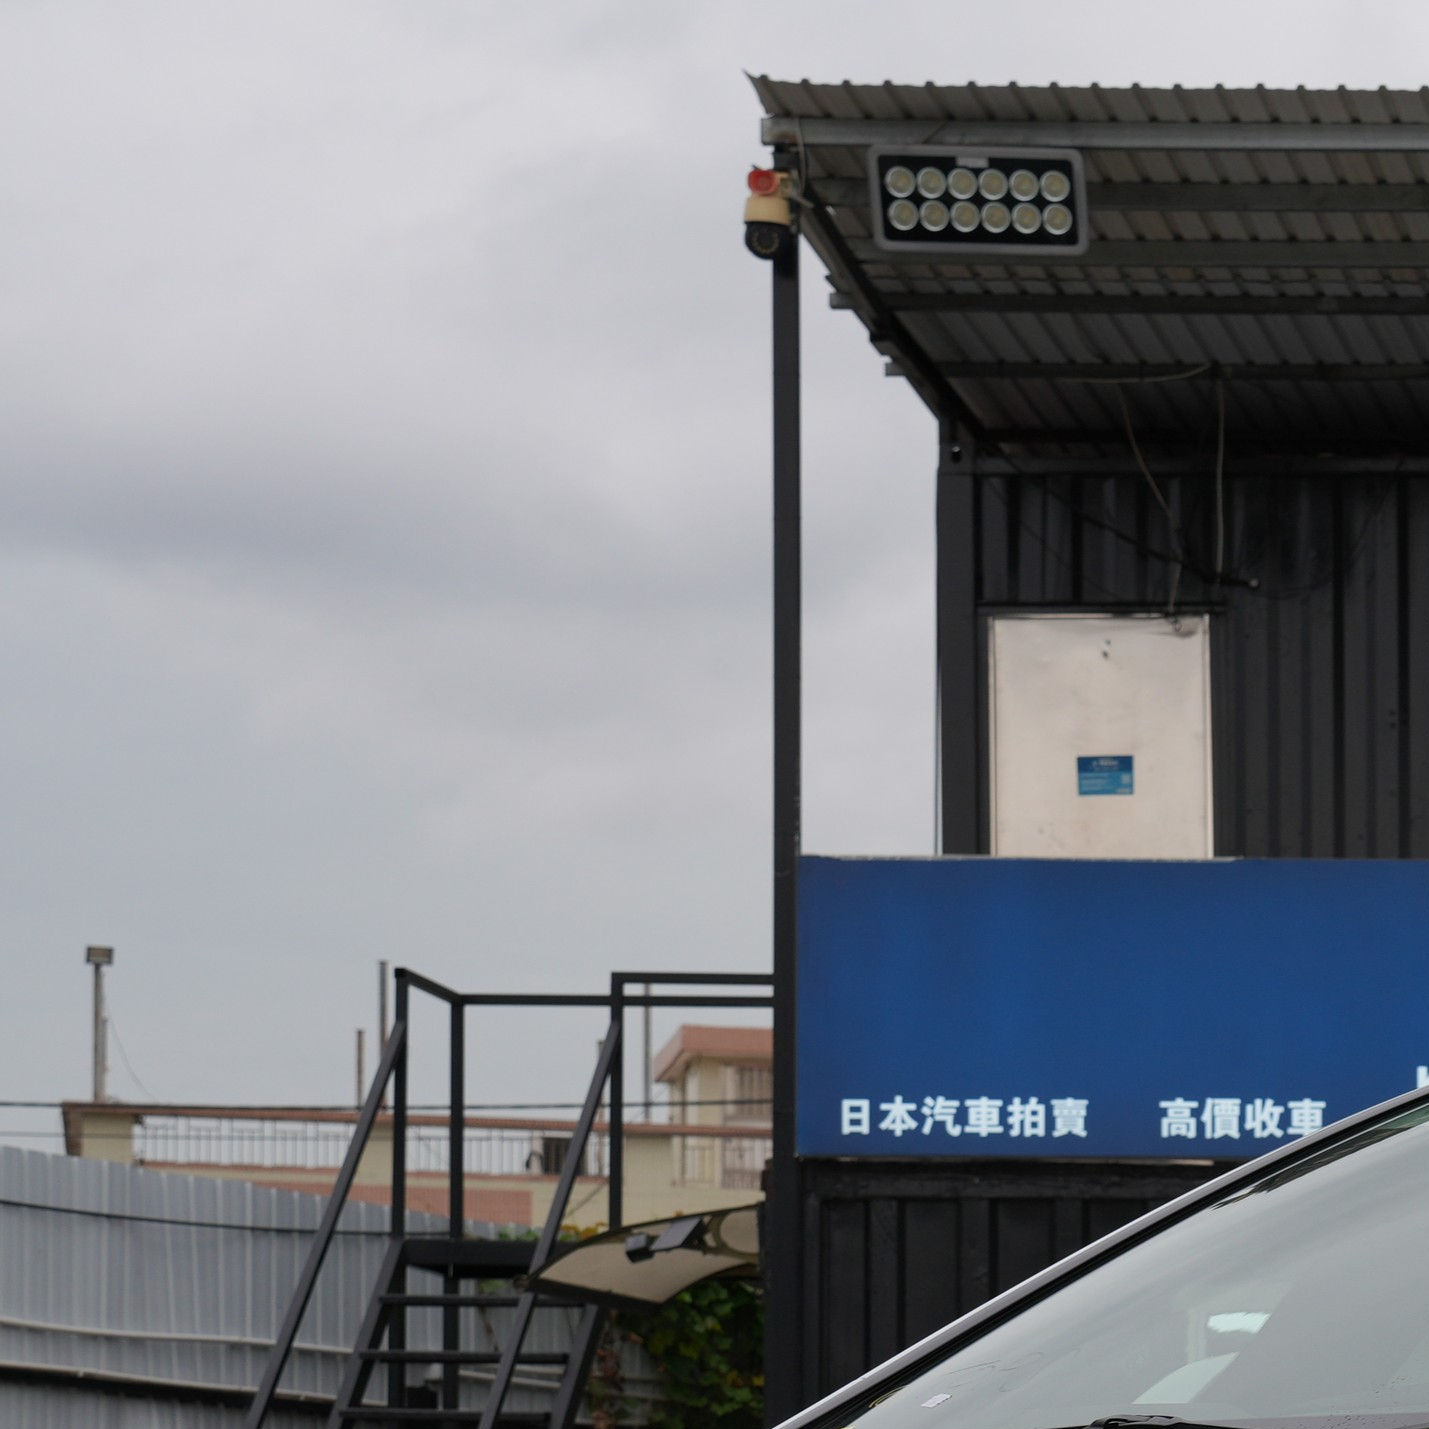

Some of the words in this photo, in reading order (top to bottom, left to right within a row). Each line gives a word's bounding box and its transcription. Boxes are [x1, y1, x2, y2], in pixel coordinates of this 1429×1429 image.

[841, 1096, 1088, 1138] 日本汽車拍賣
[1159, 1097, 1327, 1139] 高價收車
